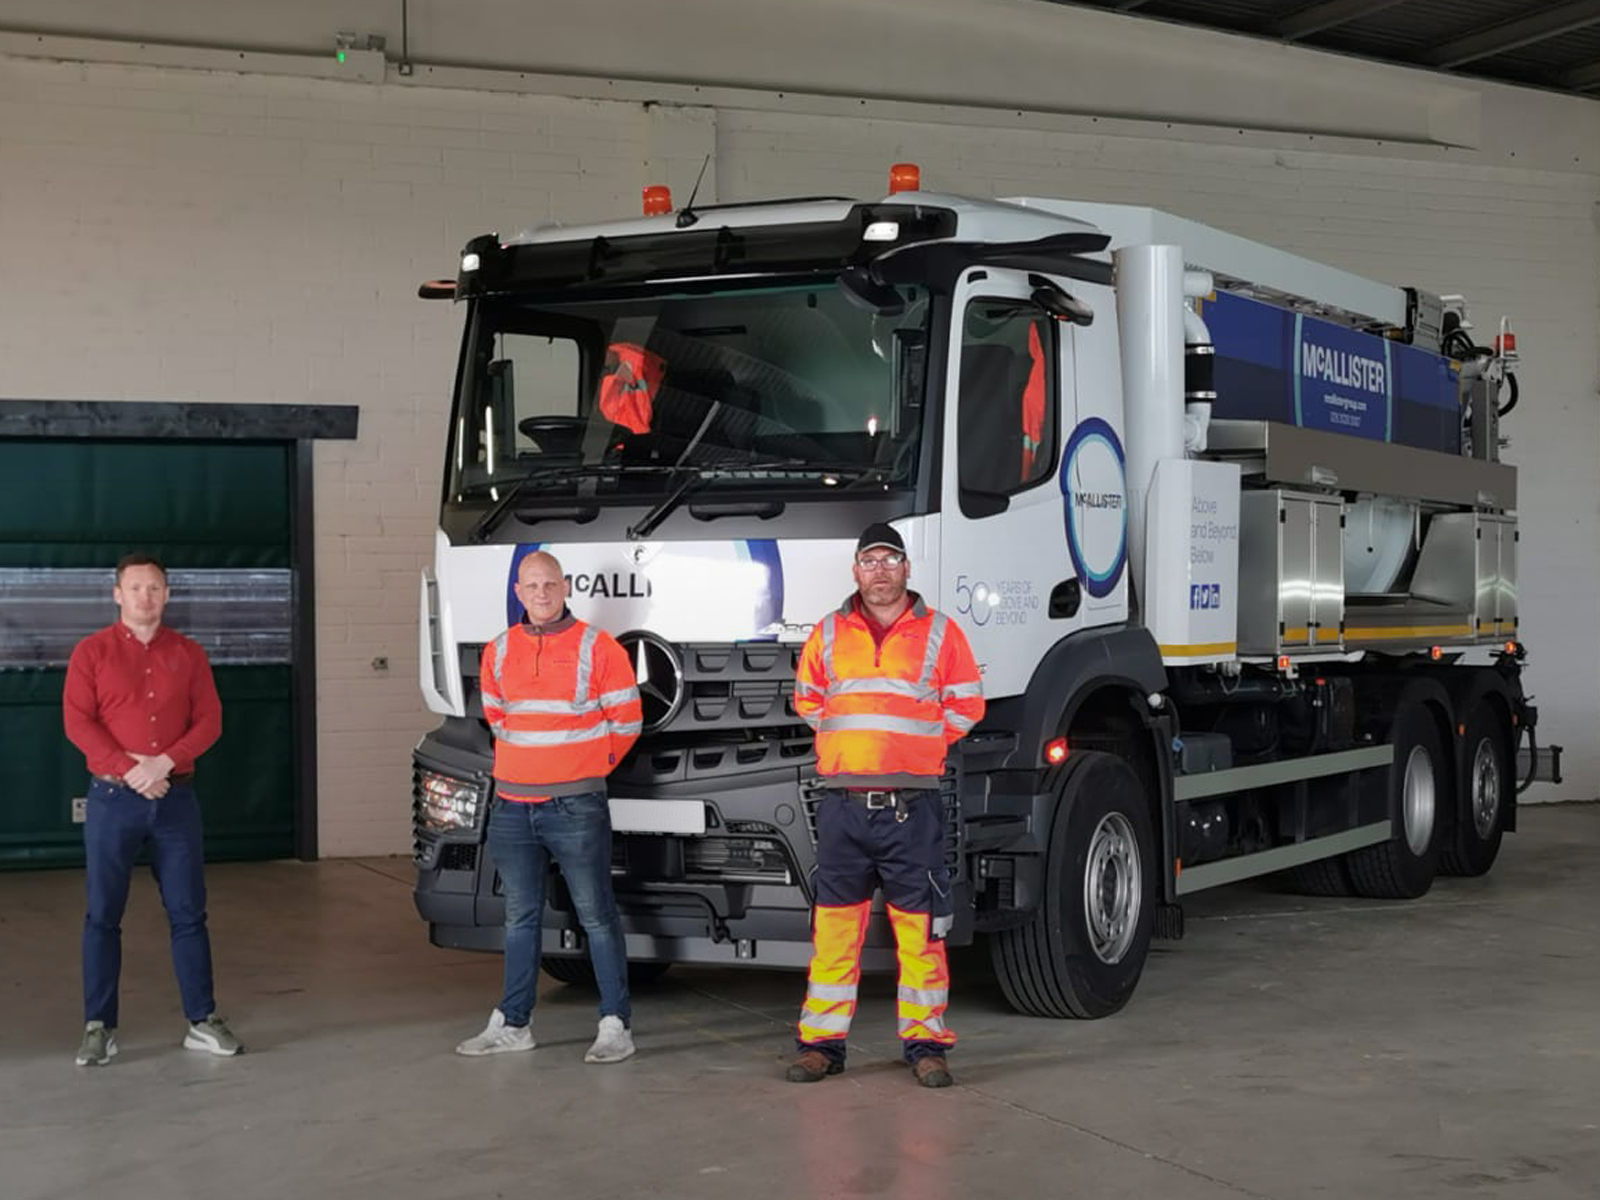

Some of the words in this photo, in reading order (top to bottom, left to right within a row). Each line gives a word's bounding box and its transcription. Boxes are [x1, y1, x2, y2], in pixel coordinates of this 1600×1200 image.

[1191, 497, 1217, 513] Above
[1190, 523, 1207, 539] and
[1208, 521, 1237, 543] Beyond
[1190, 546, 1214, 564] Below
[955, 574, 992, 627] 50
